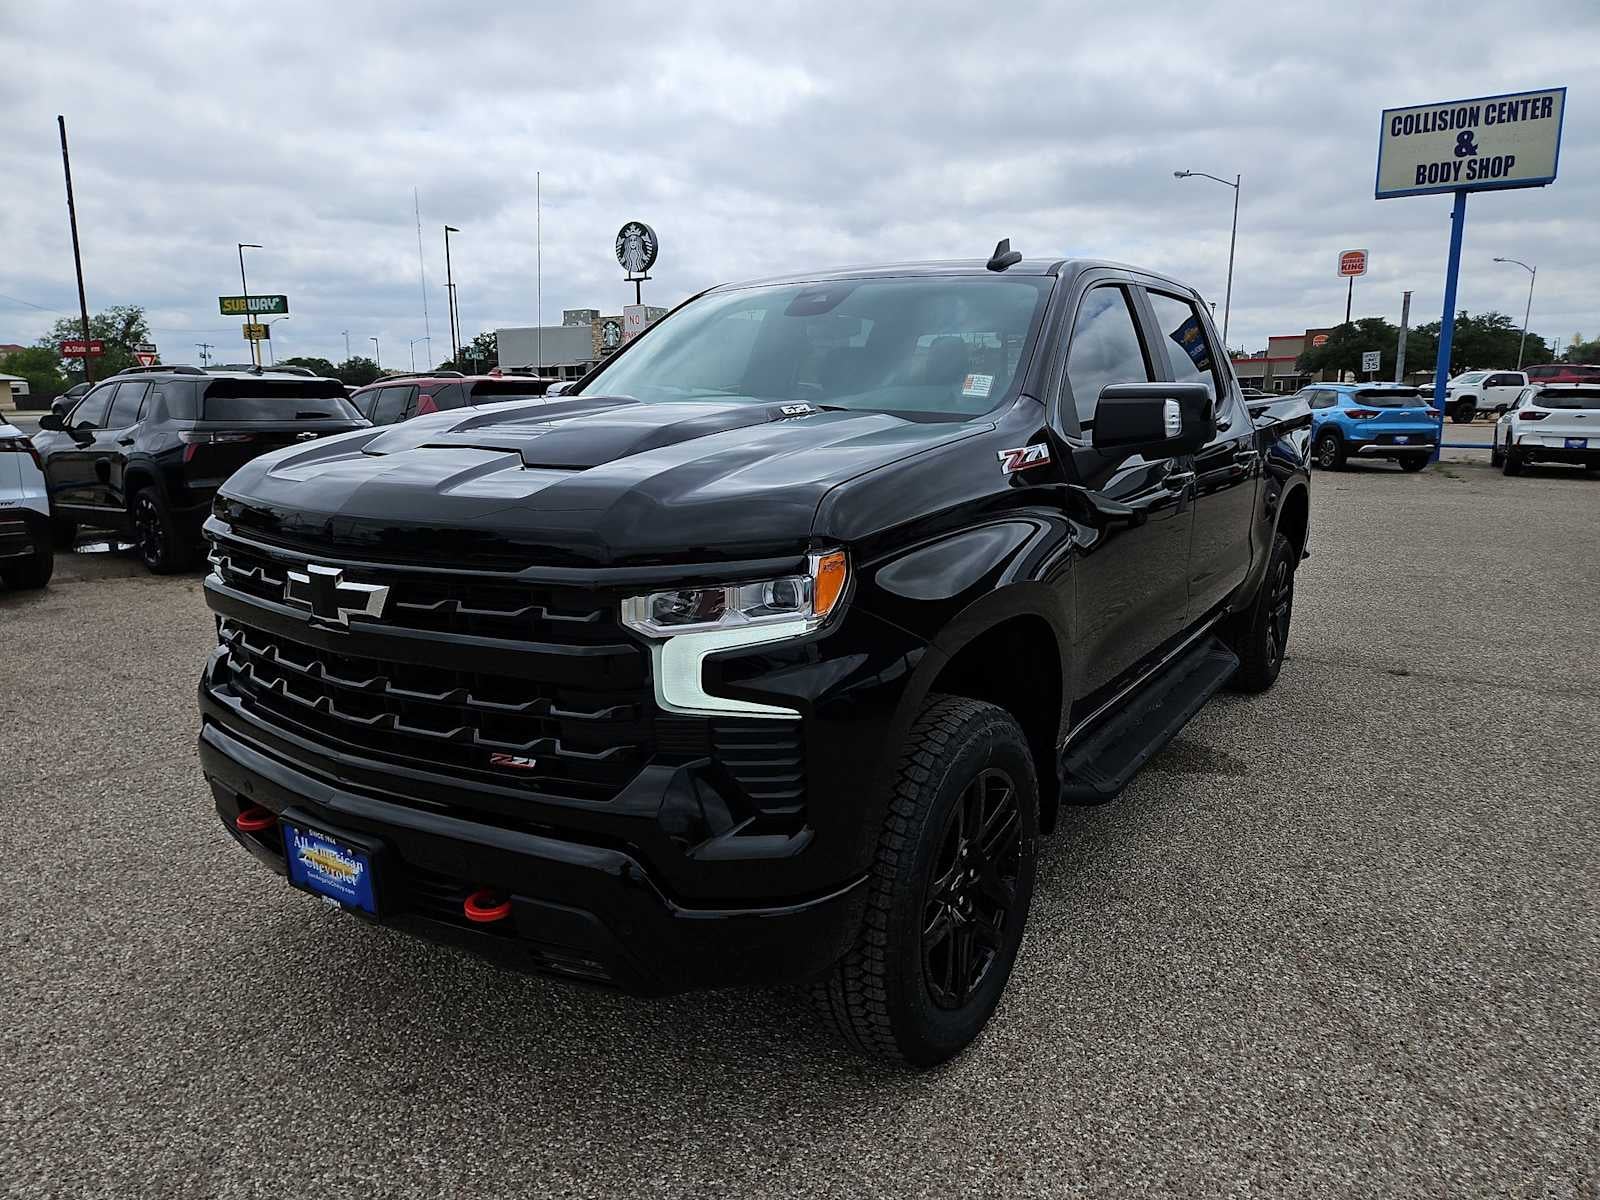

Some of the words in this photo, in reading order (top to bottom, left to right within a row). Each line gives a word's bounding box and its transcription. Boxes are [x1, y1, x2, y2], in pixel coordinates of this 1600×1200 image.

[1391, 106, 1480, 136] COLLISION
[1484, 97, 1553, 125] CENTER
[1454, 131, 1478, 157] &
[1415, 160, 1463, 185] BODY
[1466, 155, 1515, 180] SHOP
[223, 298, 280, 311] SUBWAY
[629, 315, 640, 325] NO
[1364, 361, 1378, 370] 35
[997, 443, 1050, 475] Z71
[294, 836, 308, 848] All
[313, 842, 364, 873] American
[304, 854, 360, 886] Chevrolet
